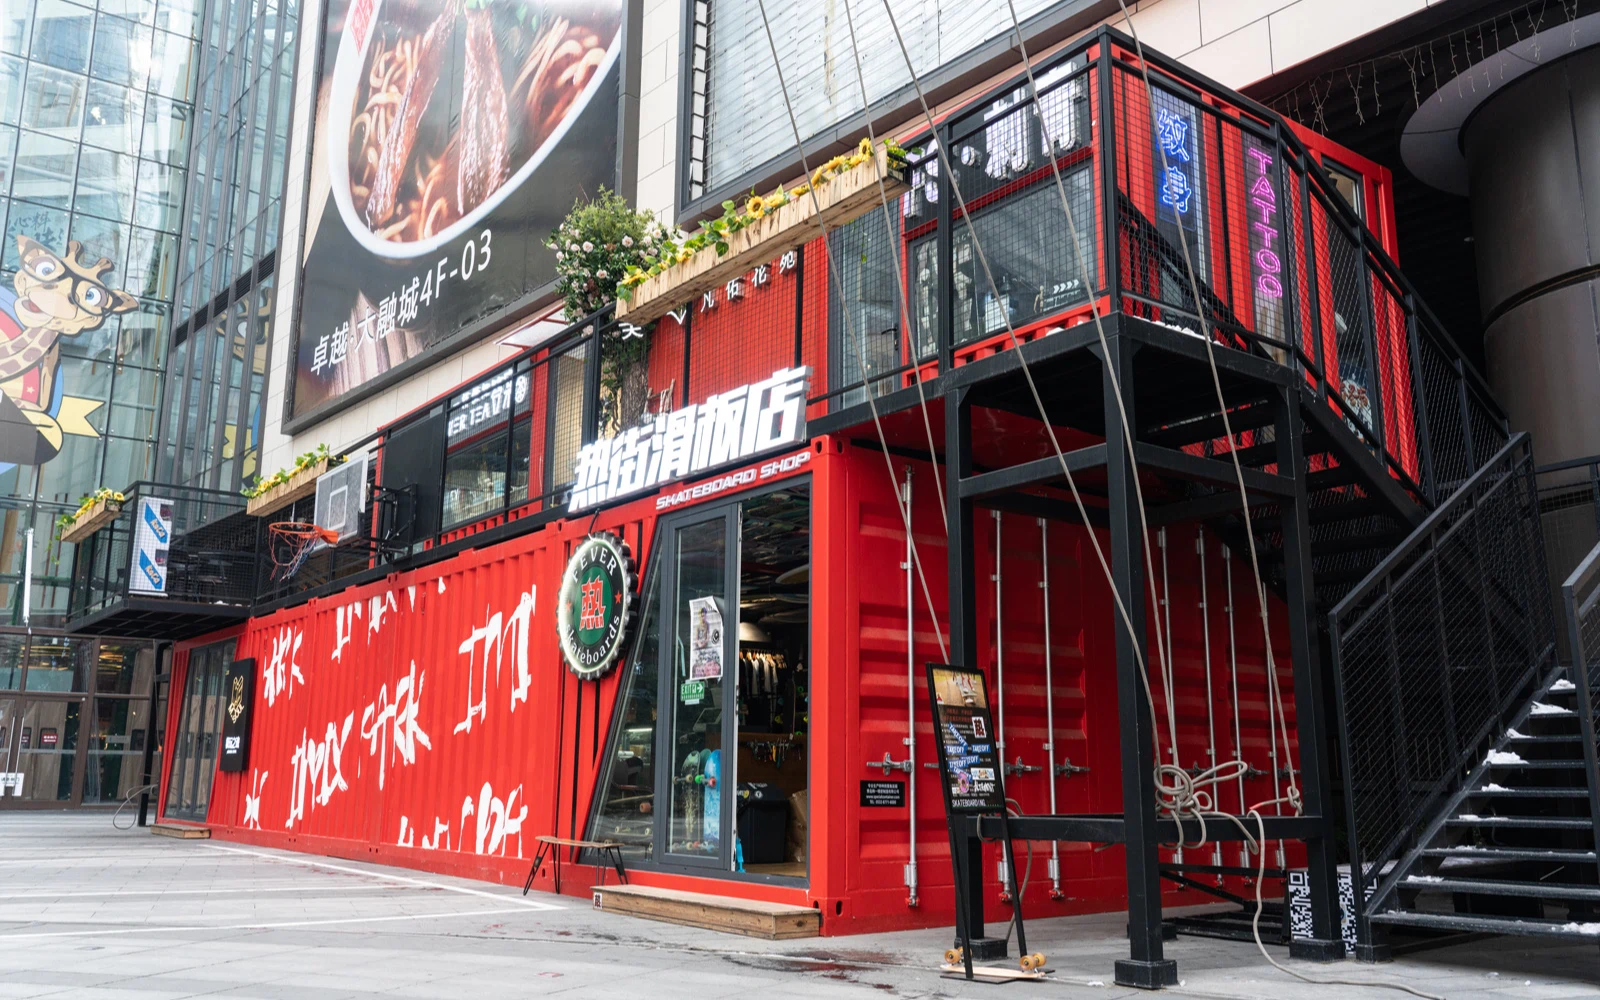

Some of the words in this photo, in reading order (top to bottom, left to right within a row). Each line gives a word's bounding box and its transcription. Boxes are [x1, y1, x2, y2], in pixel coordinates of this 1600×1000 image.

[1248, 147, 1283, 298] TATTOO
[568, 366, 808, 513] 热街滑板店
[656, 468, 757, 510] SKATEBOARD
[760, 452, 811, 479] SHOP
[572, 546, 617, 584] FEVER
[565, 615, 620, 665] skateboards
